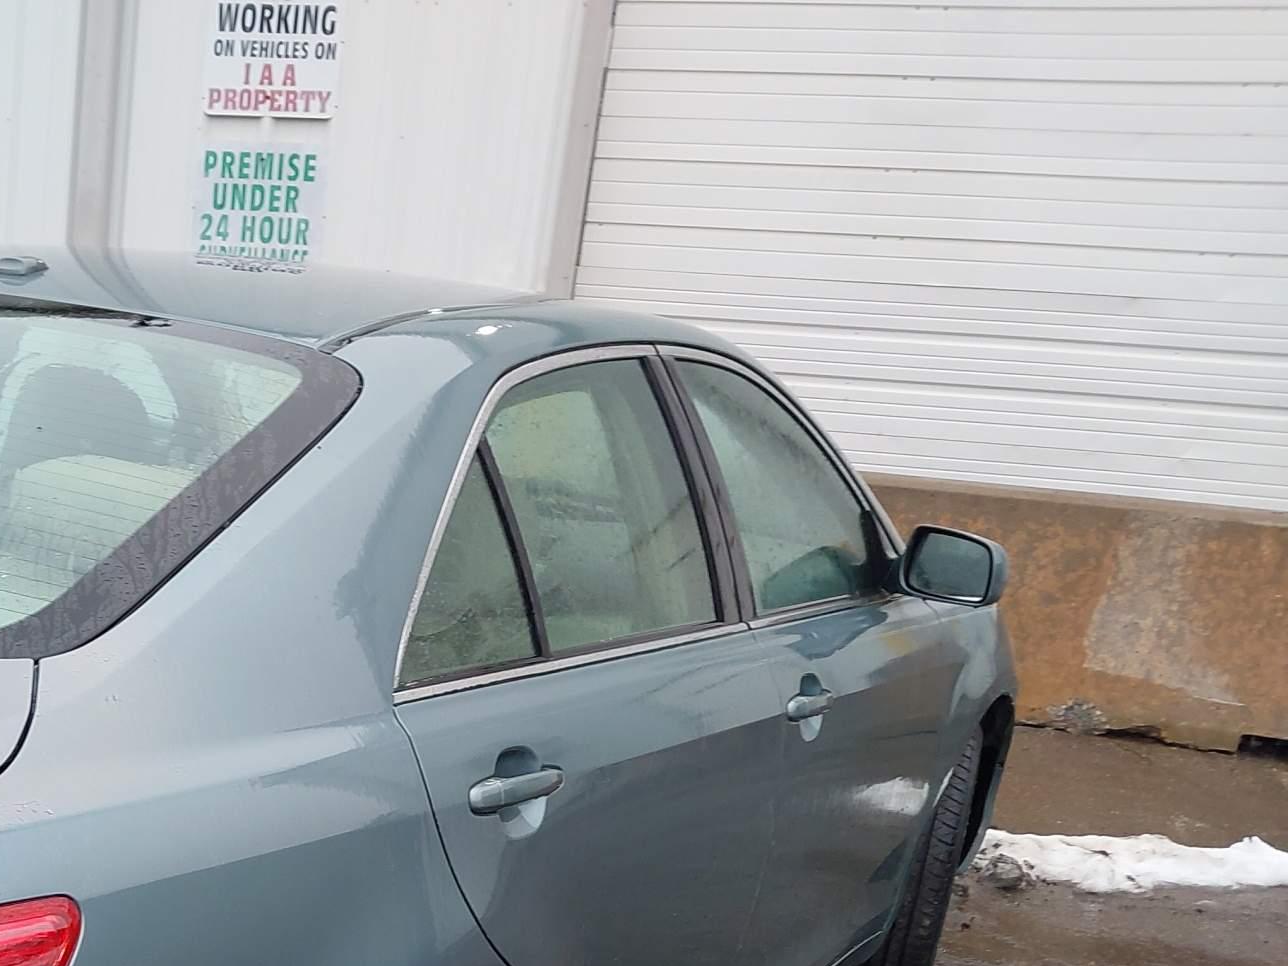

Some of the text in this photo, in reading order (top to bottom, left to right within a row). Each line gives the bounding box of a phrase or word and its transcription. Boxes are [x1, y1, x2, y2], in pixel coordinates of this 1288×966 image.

[218, 2, 337, 36] WORKING
[214, 39, 337, 61] ON VEHICLES ON
[207, 88, 332, 114] PROPERTY
[203, 150, 317, 183] PREMISE
[213, 182, 300, 214] UNDER
[199, 213, 310, 246] 24 HOUR
